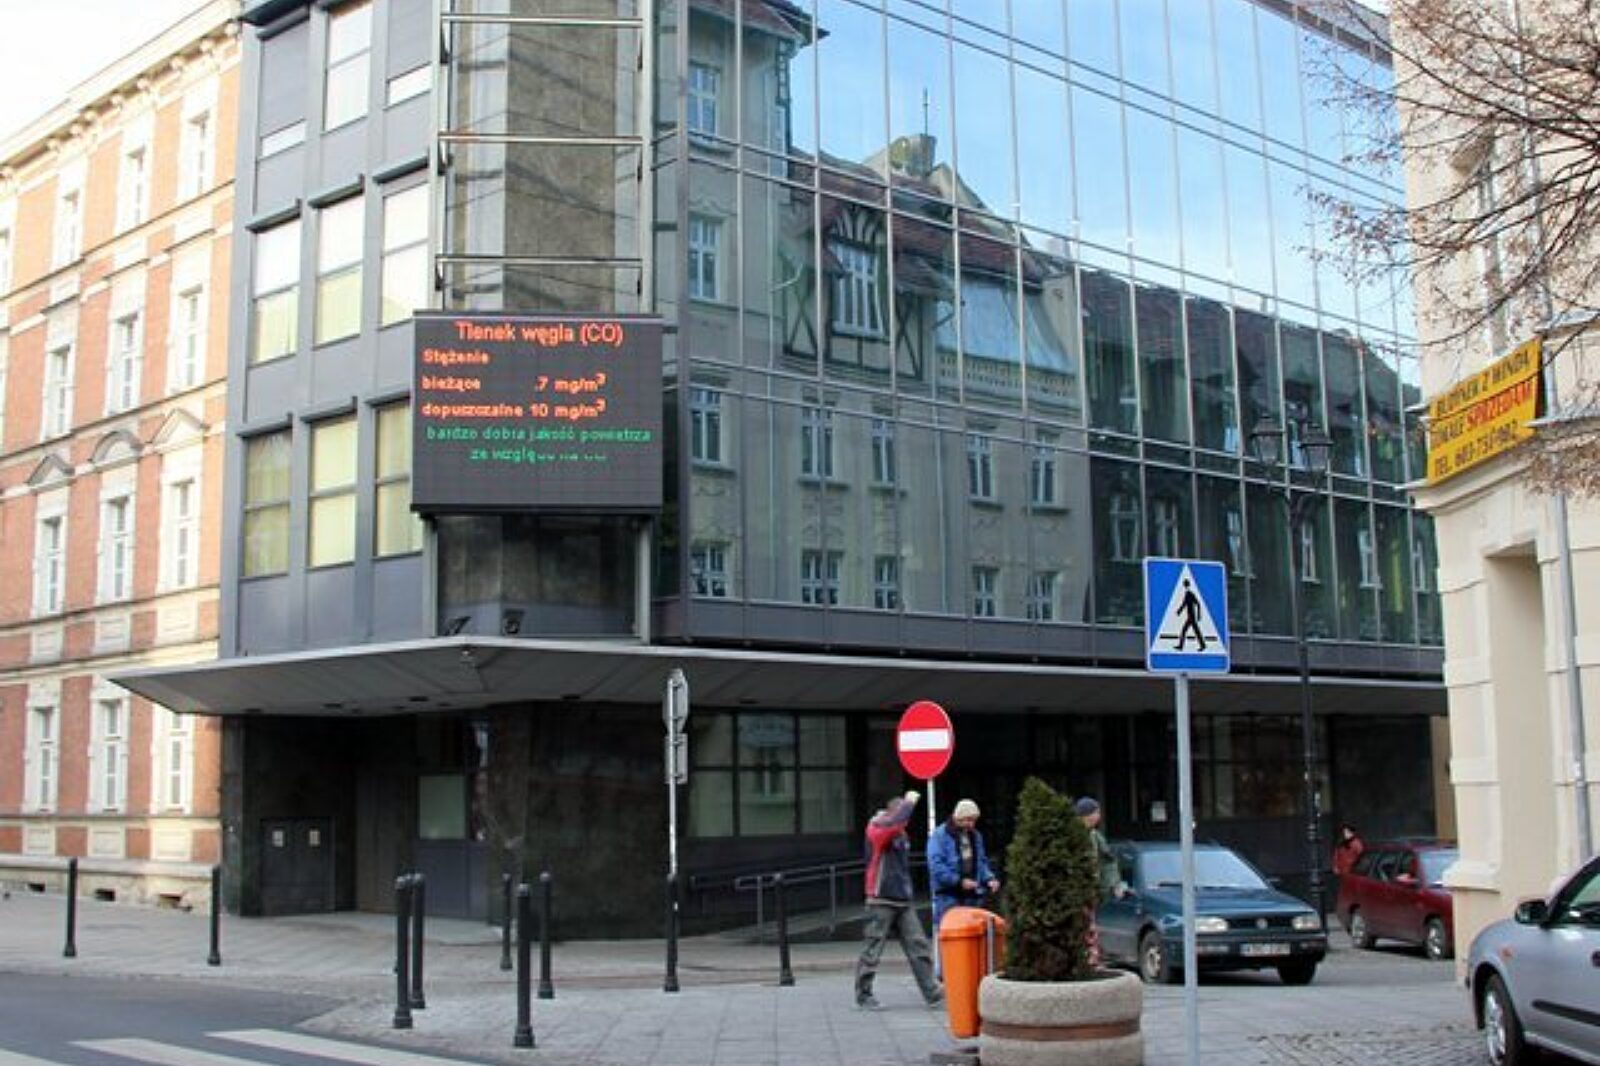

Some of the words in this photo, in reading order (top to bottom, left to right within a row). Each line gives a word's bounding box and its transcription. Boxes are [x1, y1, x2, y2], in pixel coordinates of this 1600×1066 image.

[454, 321, 516, 342] Tlenek
[521, 324, 575, 347] węgla
[579, 323, 623, 347] (CO)
[422, 349, 490, 367] Stężenie
[421, 403, 524, 420] dopuszczalne
[529, 403, 549, 418] 10
[427, 426, 478, 441] bardzo
[482, 426, 527, 441] dobra
[529, 426, 576, 443] jakość
[580, 428, 652, 444] powietrza
